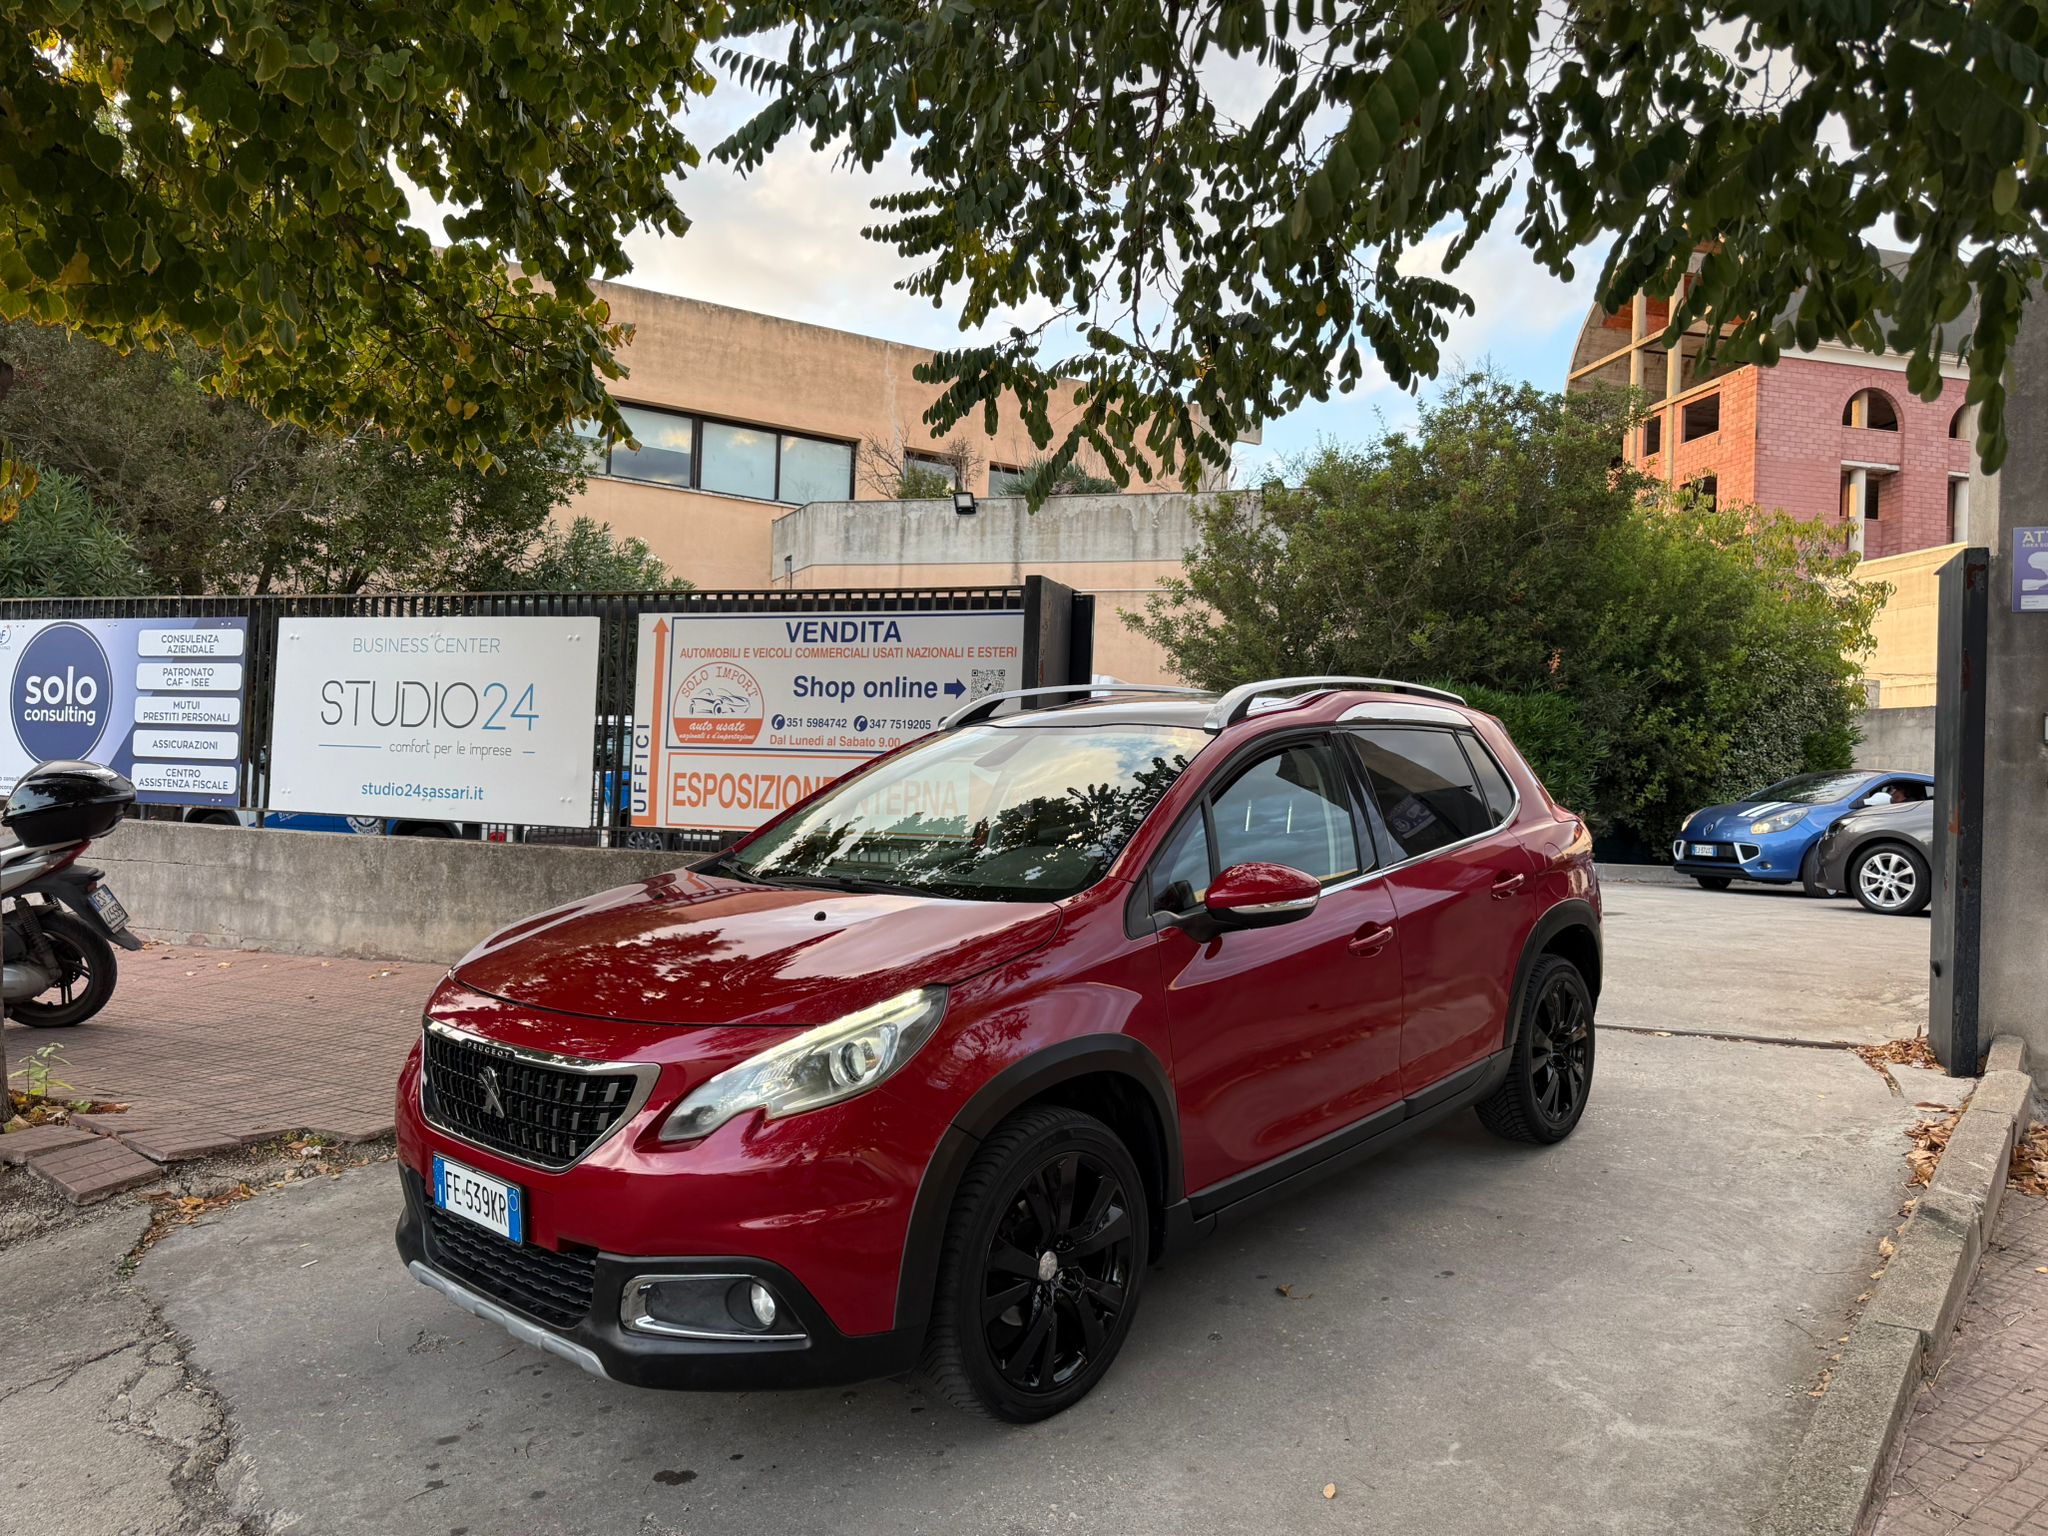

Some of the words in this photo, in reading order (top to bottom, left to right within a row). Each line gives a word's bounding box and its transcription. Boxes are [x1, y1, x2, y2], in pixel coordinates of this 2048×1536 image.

[786, 620, 902, 643] VENDITA
[161, 634, 219, 644] CONSULENZA
[352, 637, 429, 653] BUSINESS
[434, 637, 501, 654] CENTER
[166, 644, 215, 654] AZIENDALE
[680, 647, 740, 659] AUTOMOBILI
[743, 647, 750, 659] E
[753, 647, 793, 659] VEICOLI
[795, 647, 870, 659] COMMERCIALI
[873, 646, 903, 658] USATI
[906, 646, 964, 658] NAZIONALI
[967, 646, 974, 658] E
[978, 646, 1018, 658] ESTERI
[162, 667, 215, 677] PATRONATO
[25, 665, 98, 705] solo
[166, 677, 183, 687] CAF
[191, 678, 210, 687] ISEE
[681, 669, 709, 698] SOLO
[715, 666, 759, 698] IMPORT
[793, 675, 856, 703] Shop
[863, 676, 938, 699] online
[173, 700, 201, 710] MUTUI
[320, 680, 540, 732] STUDIO24
[24, 705, 97, 726] consulting
[143, 711, 180, 721] PRESTITI
[181, 713, 231, 722] PERSONALI
[689, 720, 713, 731] auto
[716, 720, 746, 731] usate
[786, 717, 803, 728] 351
[806, 718, 847, 728] 5984742
[869, 719, 887, 729] 347
[890, 719, 931, 730] 7519205
[152, 740, 218, 750] ASSICURAZIONI
[769, 734, 786, 745] Dal
[826, 736, 837, 746] al
[839, 736, 876, 747] Sabato
[879, 737, 901, 748] 9.00
[389, 738, 431, 754] comfort
[433, 743, 452, 759] per
[456, 740, 467, 755] le
[469, 742, 513, 760] imprese
[165, 768, 202, 778] CENTRO
[633, 724, 650, 813] UFFICI
[138, 778, 191, 788] ASSISTENZA
[192, 779, 229, 790] FISCALE
[360, 782, 484, 801] studio24sassari.it
[467, 1041, 510, 1059] PEUGEOT
